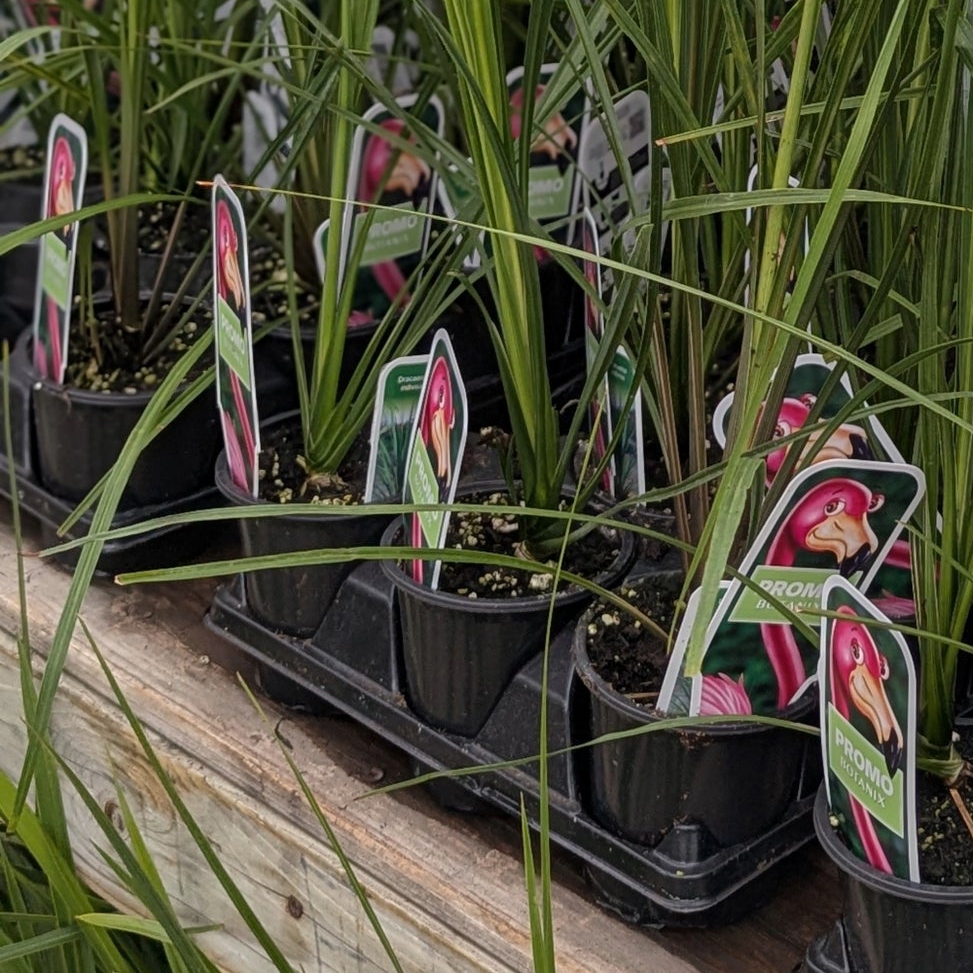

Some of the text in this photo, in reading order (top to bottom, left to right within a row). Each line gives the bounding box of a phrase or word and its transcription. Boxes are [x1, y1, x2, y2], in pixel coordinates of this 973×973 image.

[759, 579, 822, 598] PROM
[835, 728, 894, 796] PROMO
[840, 756, 886, 809] BOTANIX
